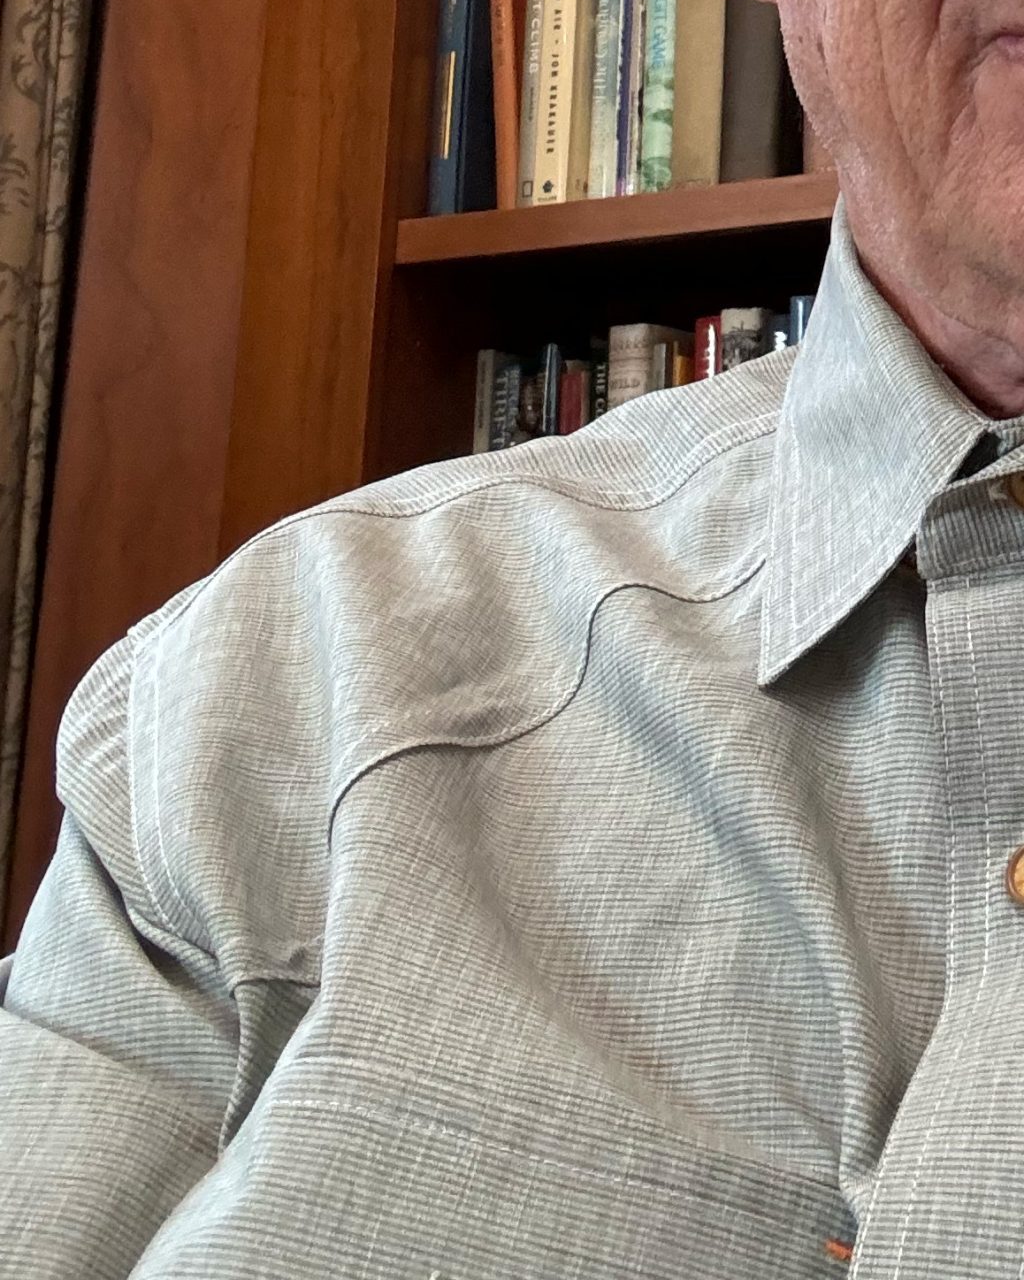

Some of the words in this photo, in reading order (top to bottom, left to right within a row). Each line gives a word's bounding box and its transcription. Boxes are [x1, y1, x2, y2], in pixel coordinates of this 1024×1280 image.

[553, 10, 562, 30] AIR
[529, 18, 541, 74] CLIMB
[551, 54, 559, 77] JON
[651, 25, 667, 71] GAME
[546, 85, 559, 154] KRAKAUER
